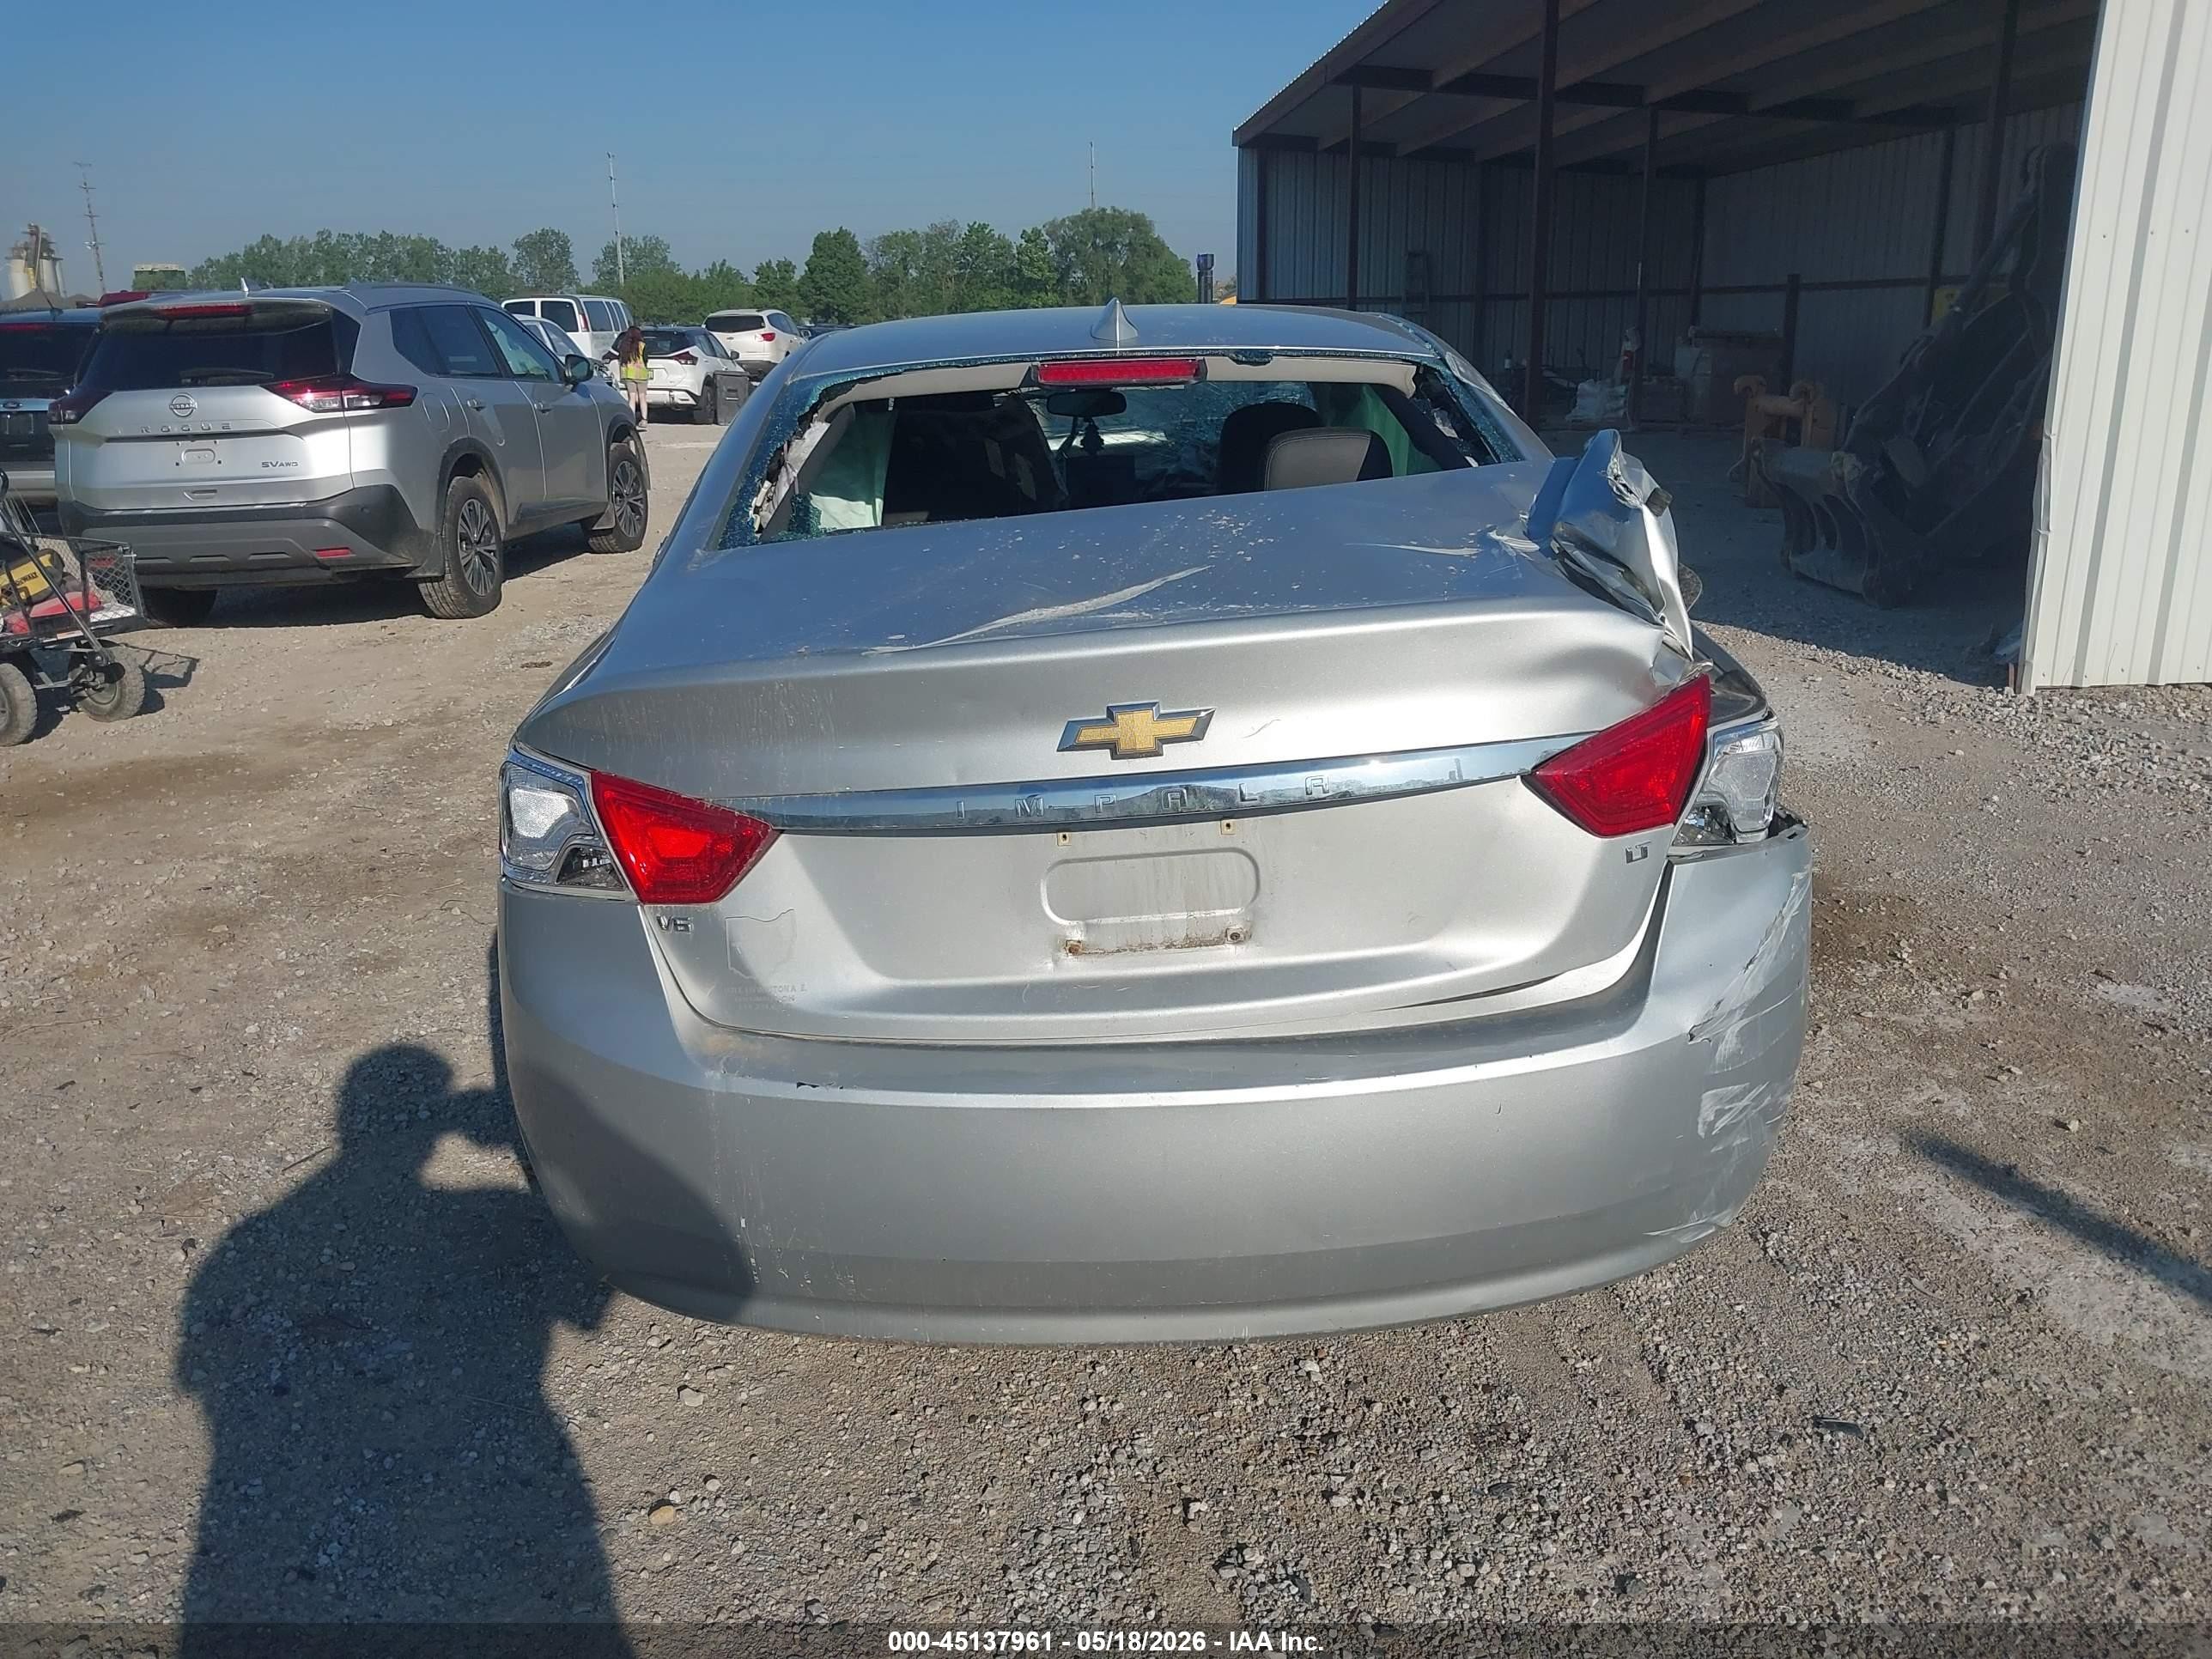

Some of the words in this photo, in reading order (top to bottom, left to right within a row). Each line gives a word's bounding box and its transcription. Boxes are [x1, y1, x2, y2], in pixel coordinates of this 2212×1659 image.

[141, 422, 231, 434] ROGUE
[956, 775, 1330, 818] IMPALA
[1625, 841, 1652, 864] LT
[656, 914, 694, 933] V6
